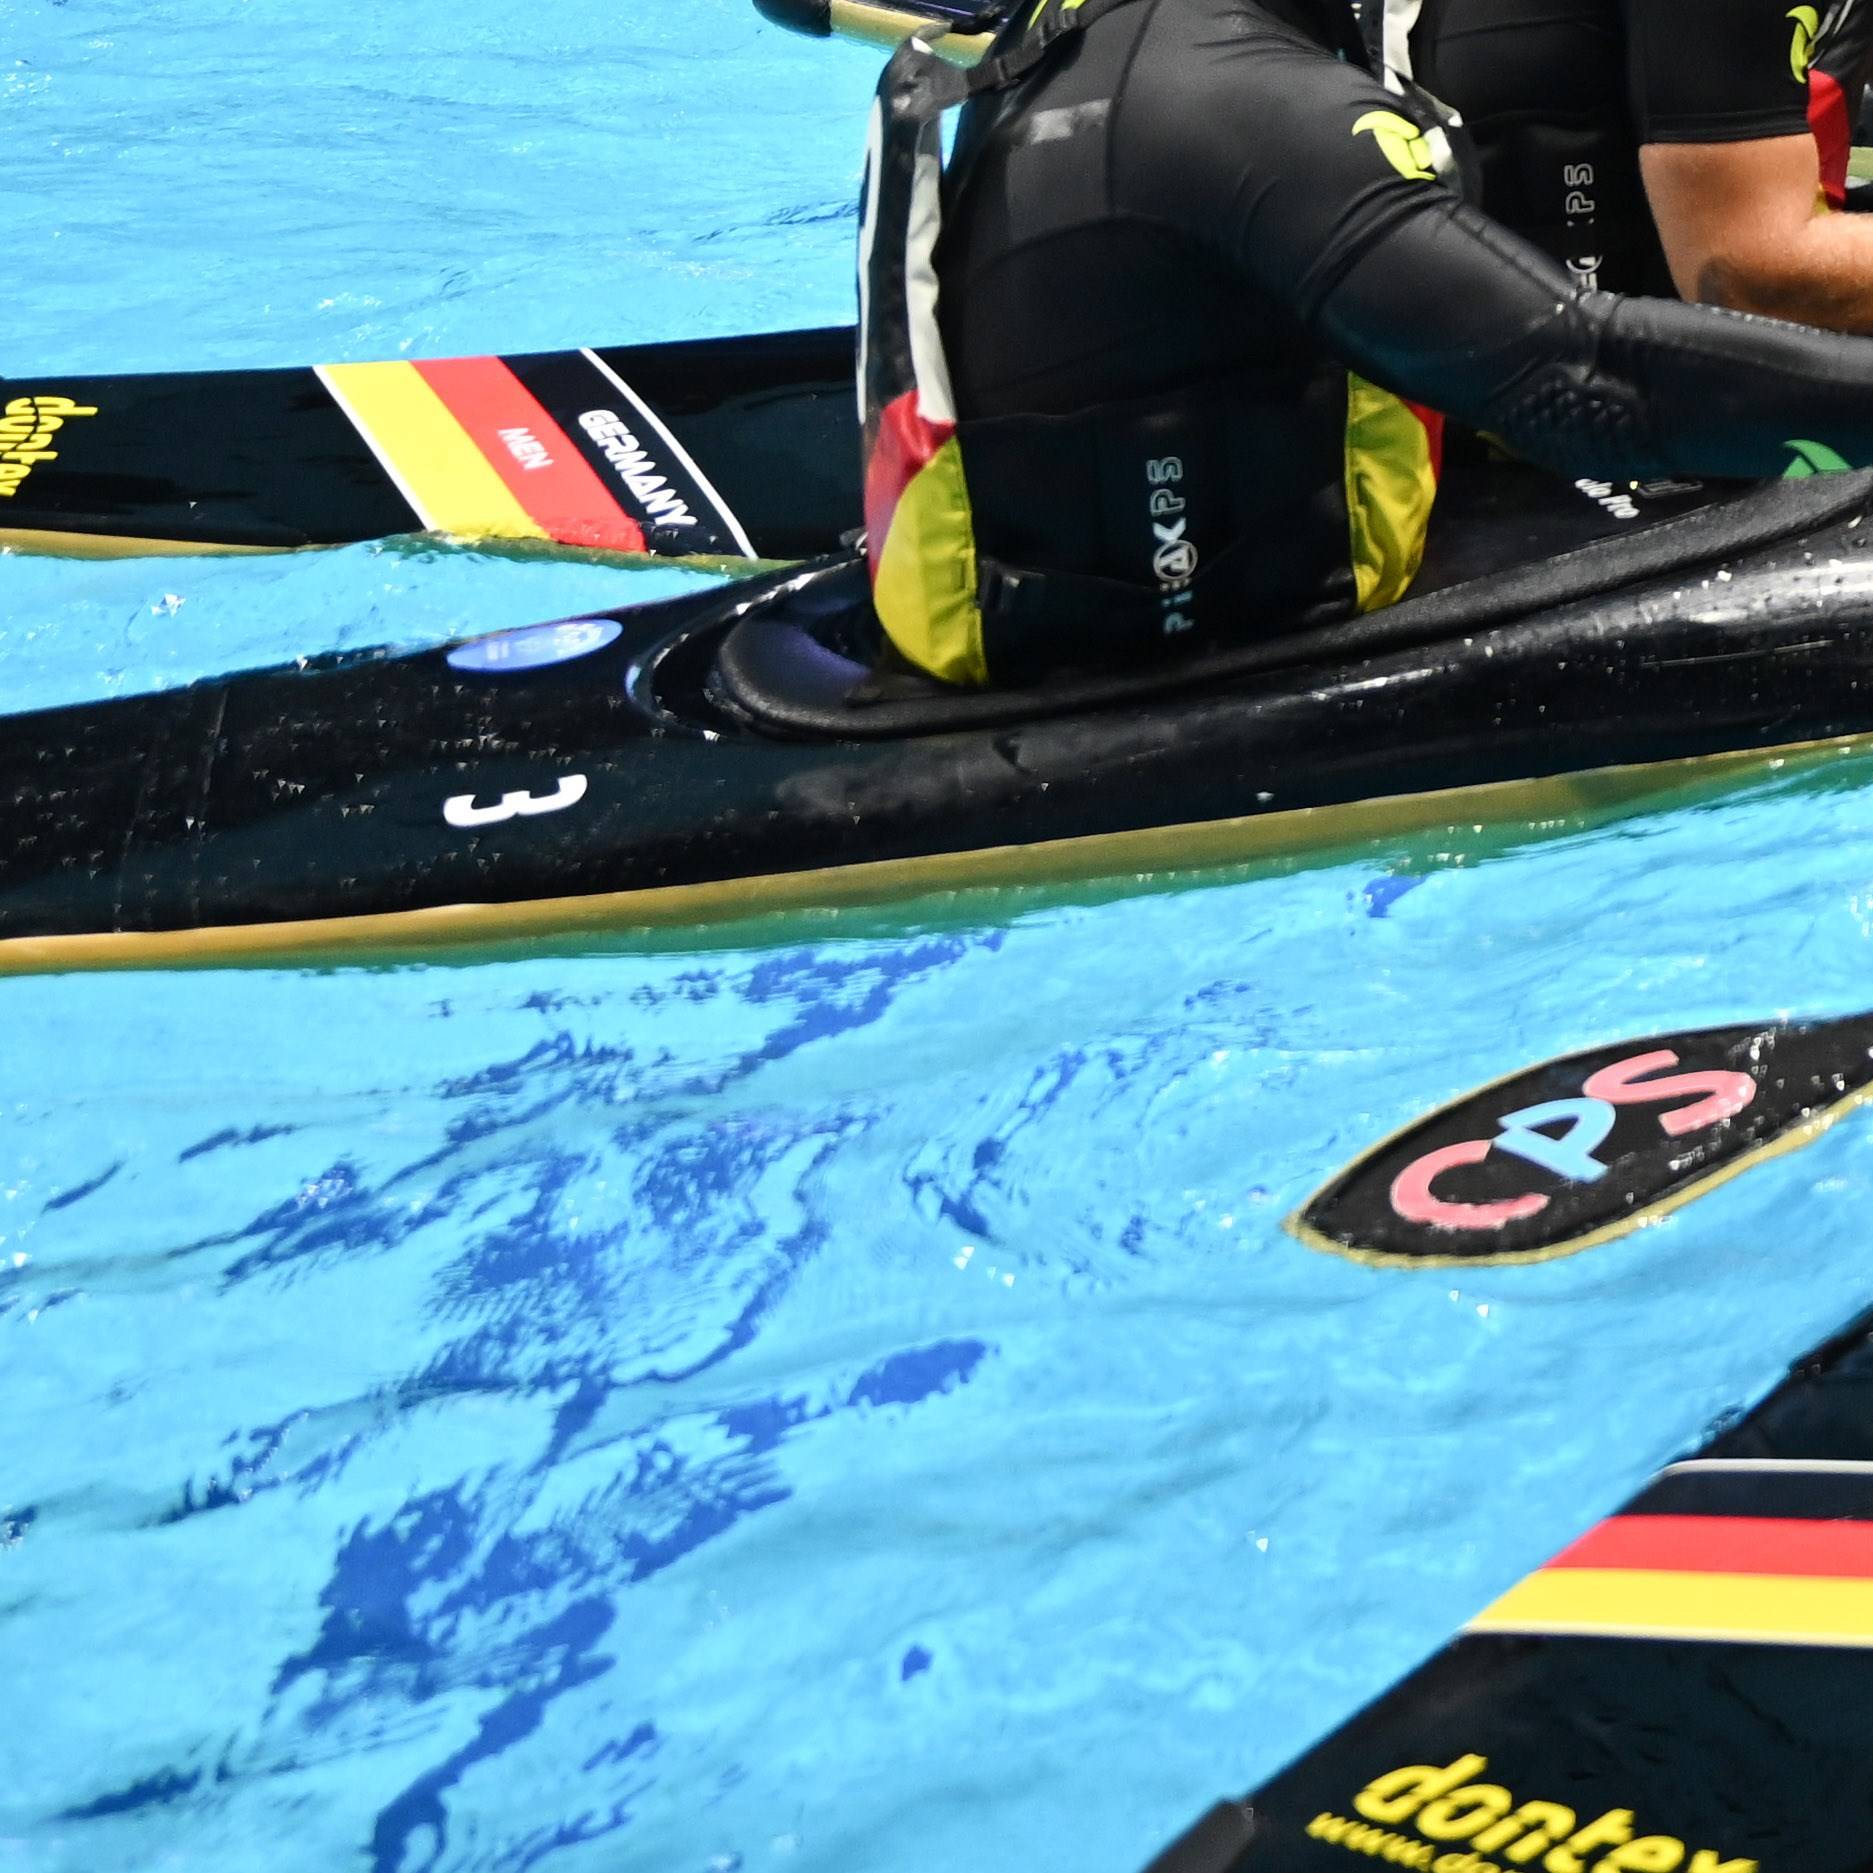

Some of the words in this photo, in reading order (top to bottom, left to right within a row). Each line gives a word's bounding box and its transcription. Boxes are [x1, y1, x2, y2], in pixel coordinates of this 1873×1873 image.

[497, 427, 555, 471] MEN
[577, 409, 699, 526] GERMANY
[442, 773, 588, 828] 3
[1390, 1048, 1758, 1230] CPS
